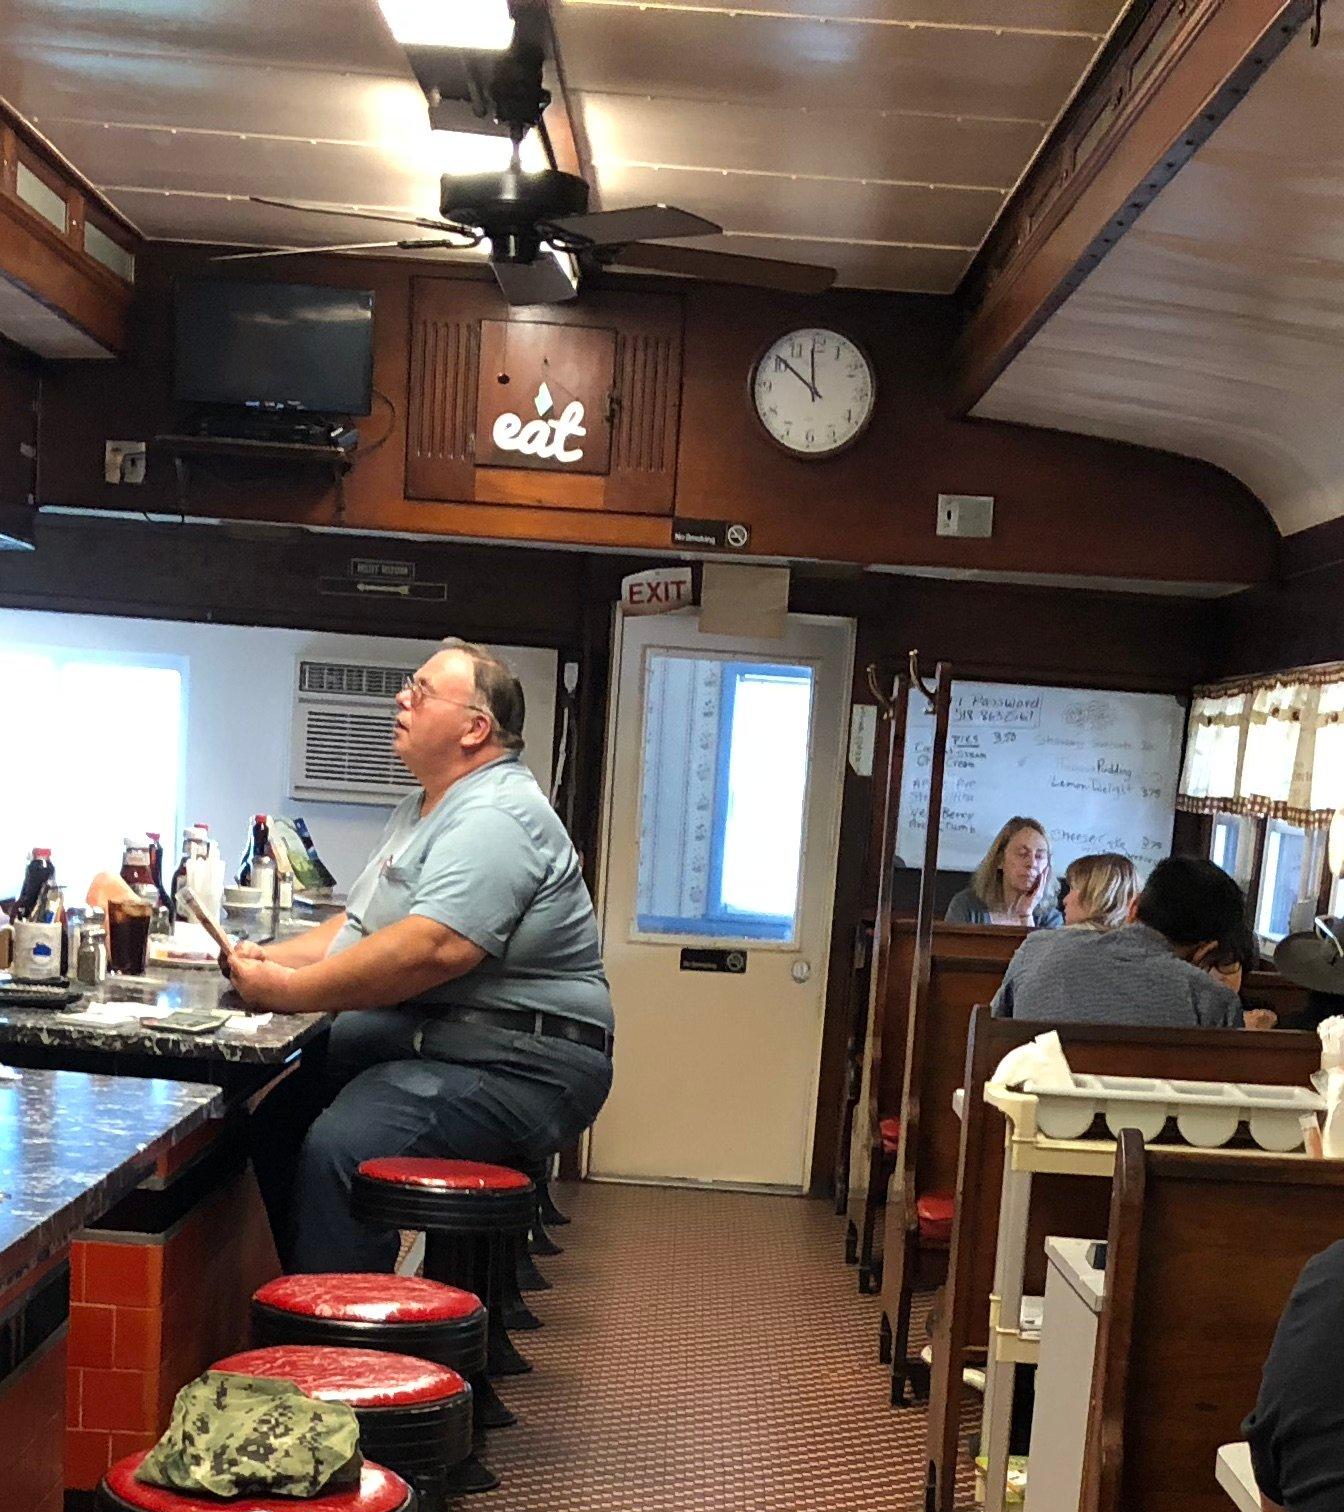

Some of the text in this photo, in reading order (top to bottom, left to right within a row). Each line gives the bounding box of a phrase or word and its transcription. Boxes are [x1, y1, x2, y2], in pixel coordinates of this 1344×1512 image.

[492, 400, 587, 463] eat
[686, 533, 716, 545] Smoking
[628, 580, 687, 605] EXIT
[1095, 757, 1133, 778] Pudding
